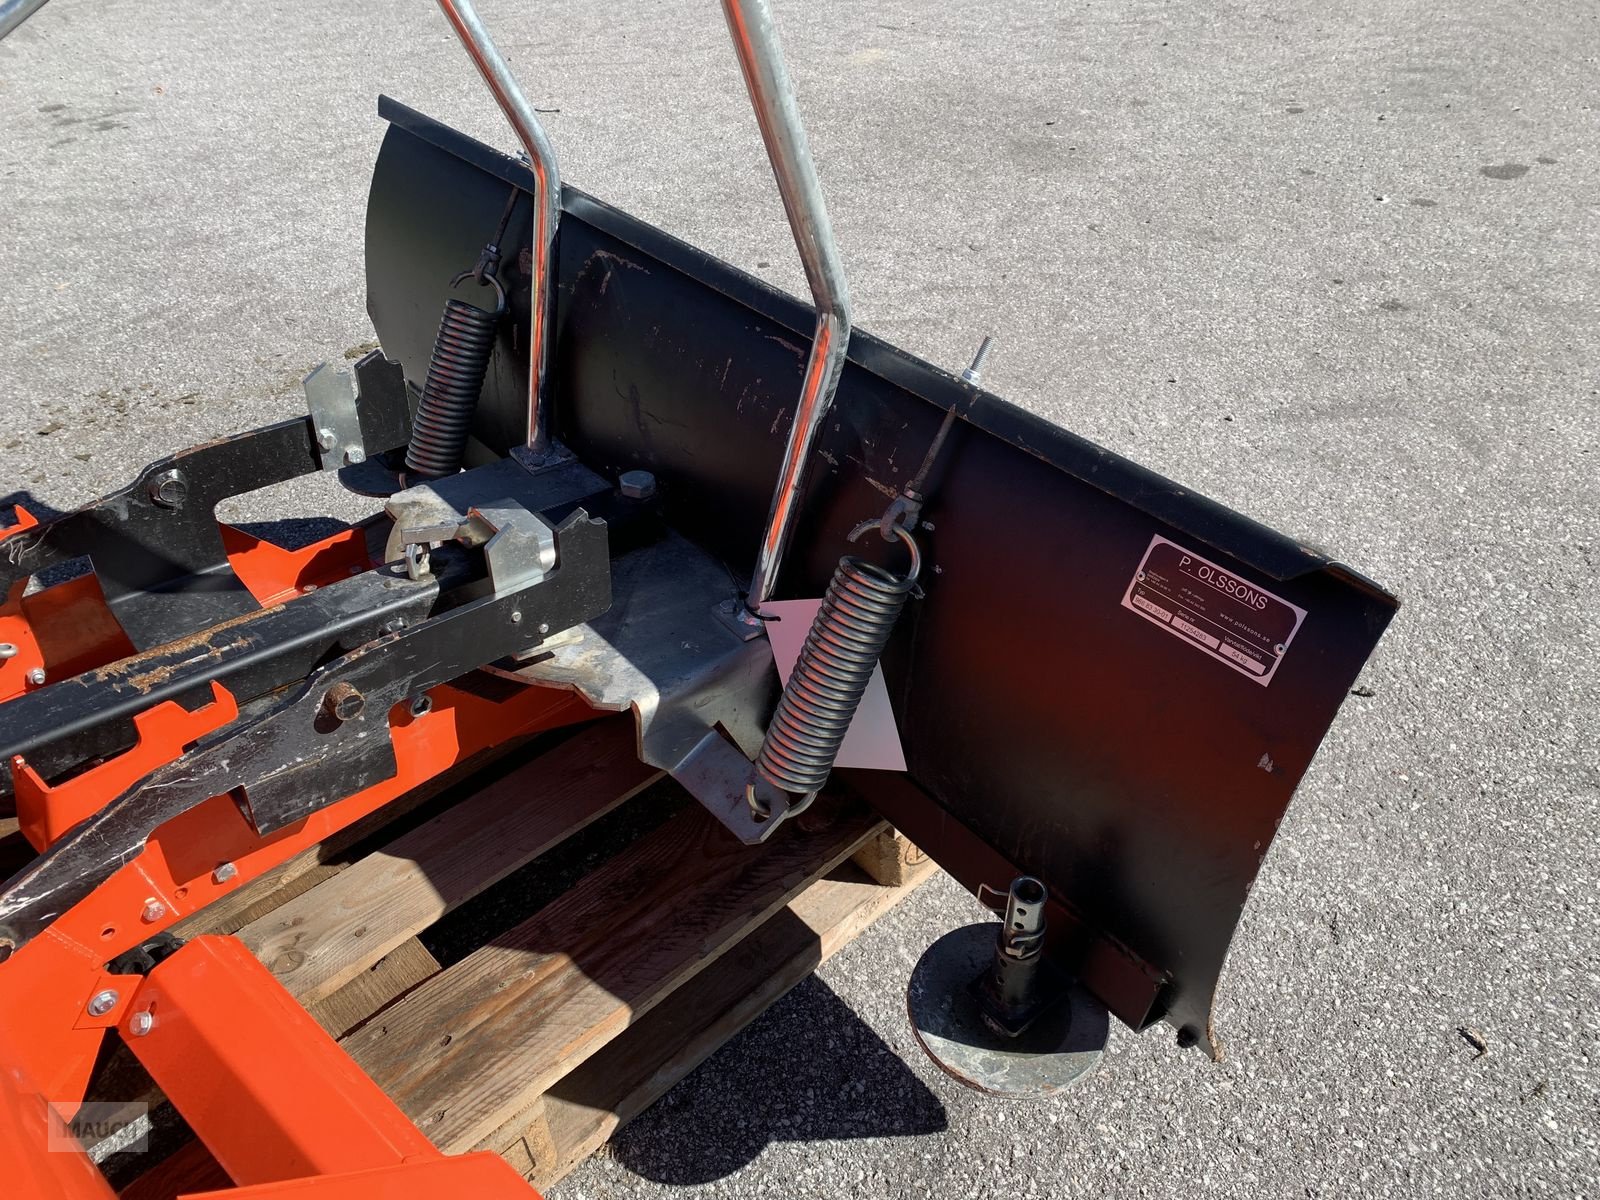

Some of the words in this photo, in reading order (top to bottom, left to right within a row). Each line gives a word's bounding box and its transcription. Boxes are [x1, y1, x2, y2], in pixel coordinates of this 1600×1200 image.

[1179, 555, 1191, 572] P.
[1198, 566, 1268, 610] OLSSONS
[1138, 588, 1146, 596] Typ
[1177, 610, 1190, 620] Serie
[1231, 650, 1241, 660] 54
[1240, 656, 1248, 665] kg
